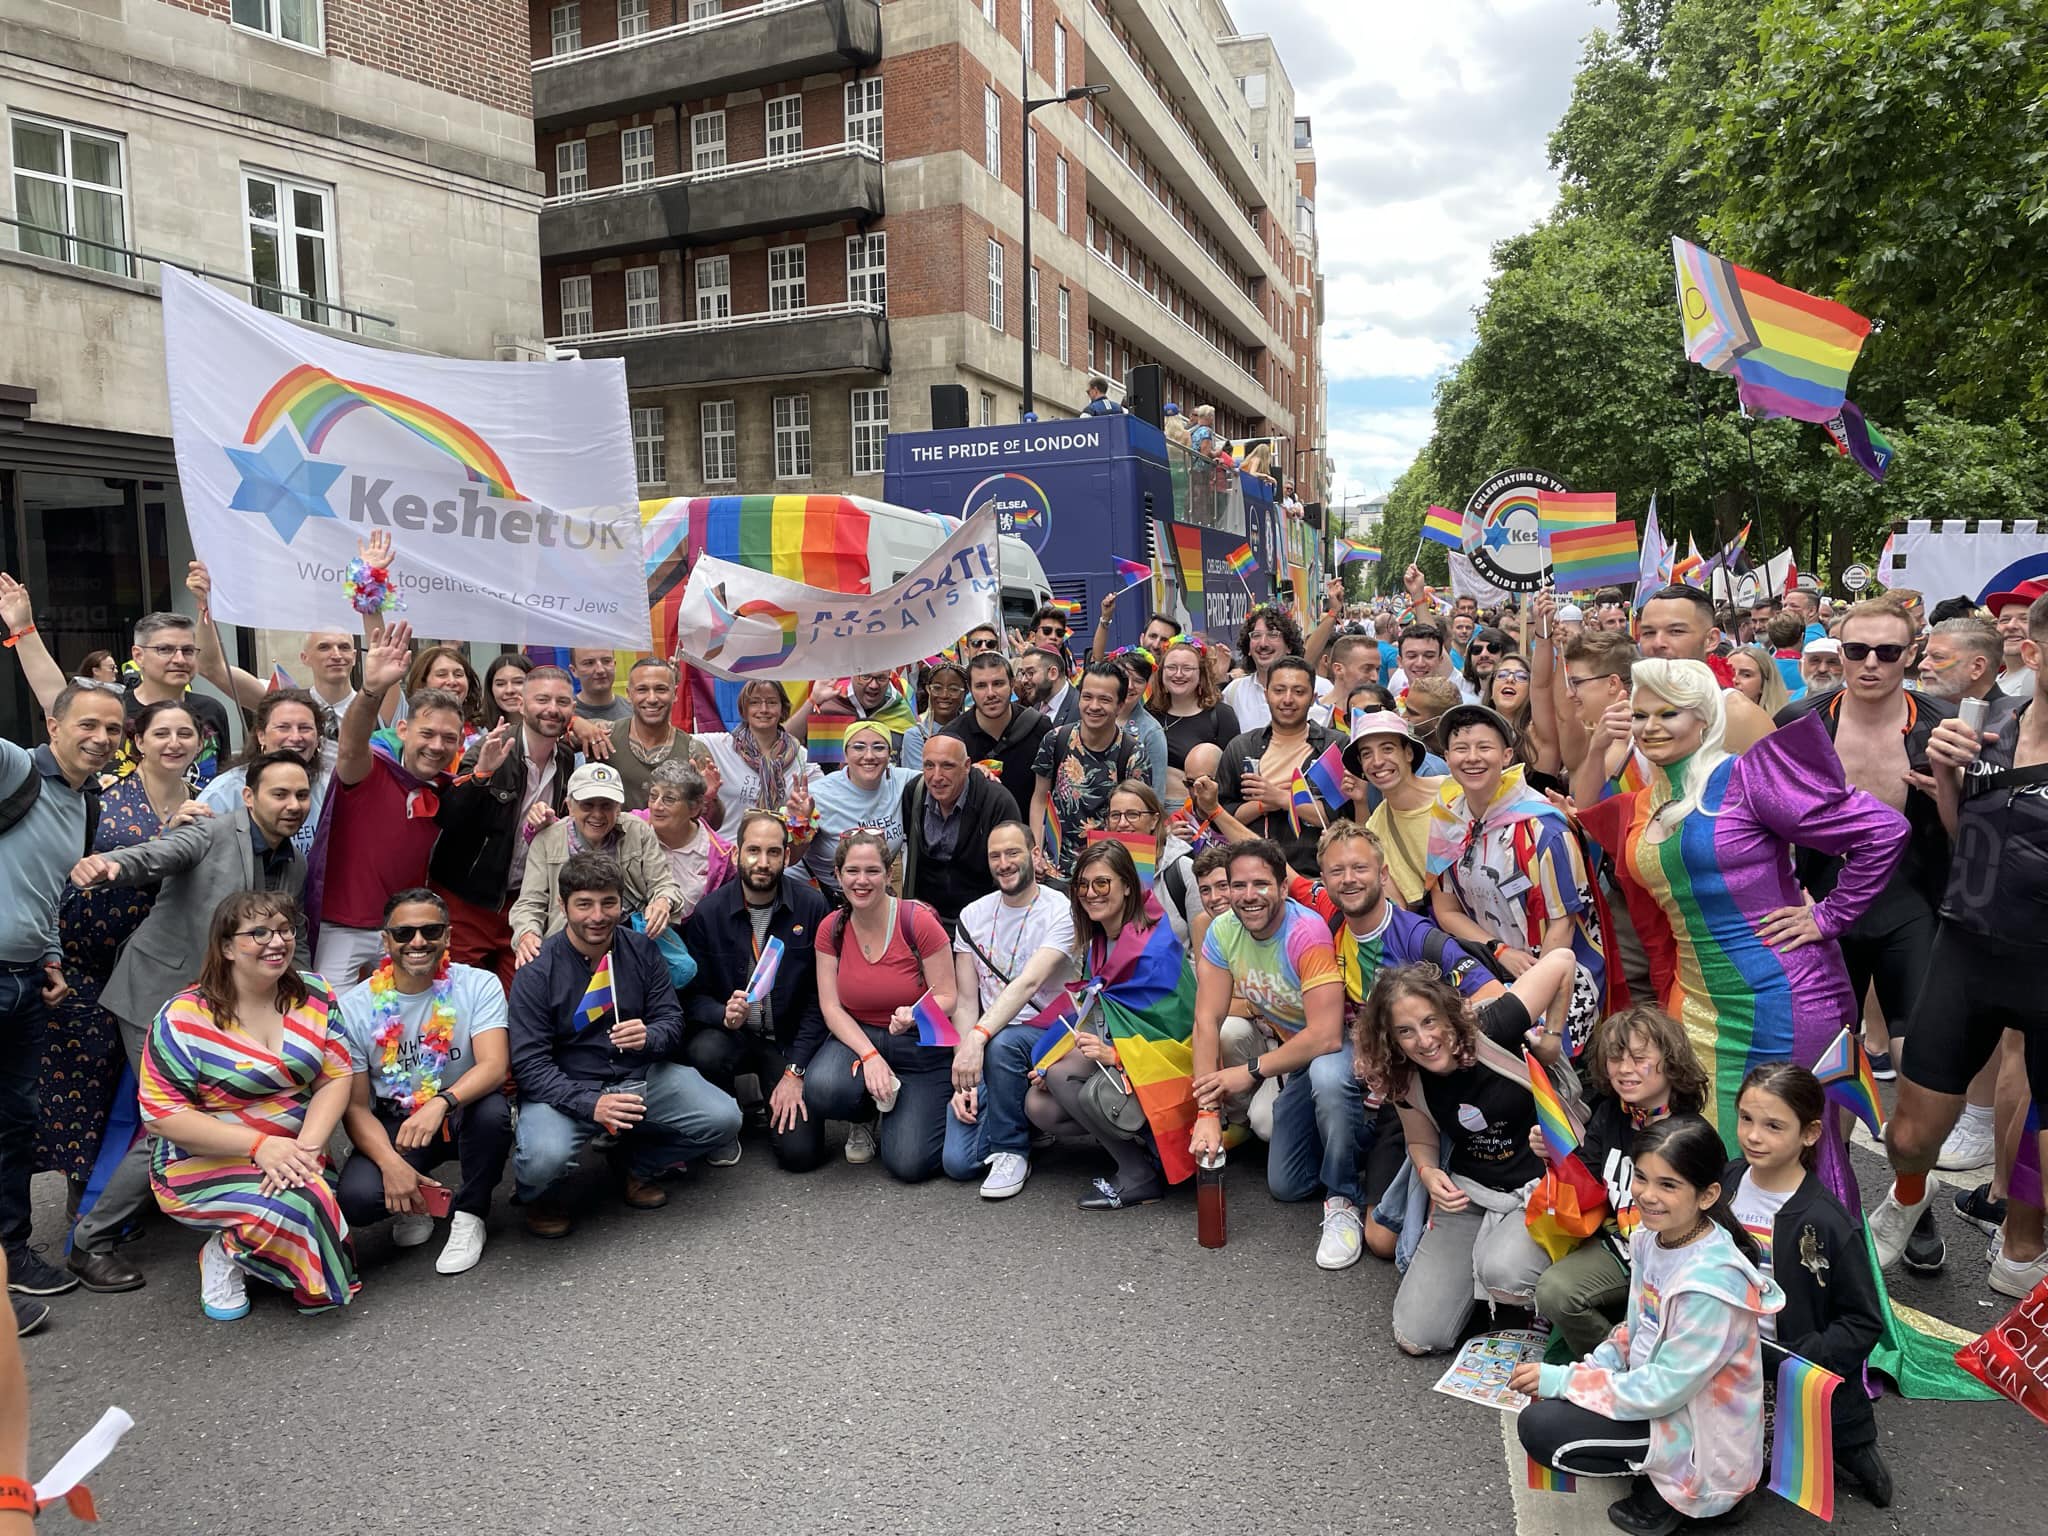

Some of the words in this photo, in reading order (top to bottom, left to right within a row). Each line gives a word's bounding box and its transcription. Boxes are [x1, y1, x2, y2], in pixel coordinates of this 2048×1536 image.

[911, 446, 944, 462] THE
[949, 441, 999, 459] PRIDE
[1003, 439, 1020, 450] OF
[1024, 432, 1100, 452] LONDON
[997, 500, 1028, 510] ELSEA
[1474, 472, 1533, 510] CELEBRATING
[1535, 474, 1548, 485] 50
[1550, 479, 1567, 494] YEA
[1512, 529, 1538, 542] Kes
[1475, 557, 1486, 570] OF
[1486, 572, 1517, 589] PRIDE
[1521, 581, 1533, 590] IN
[511, 593, 569, 611] LGBT
[574, 598, 618, 614] Jews
[1207, 592, 1230, 628] PRIDE
